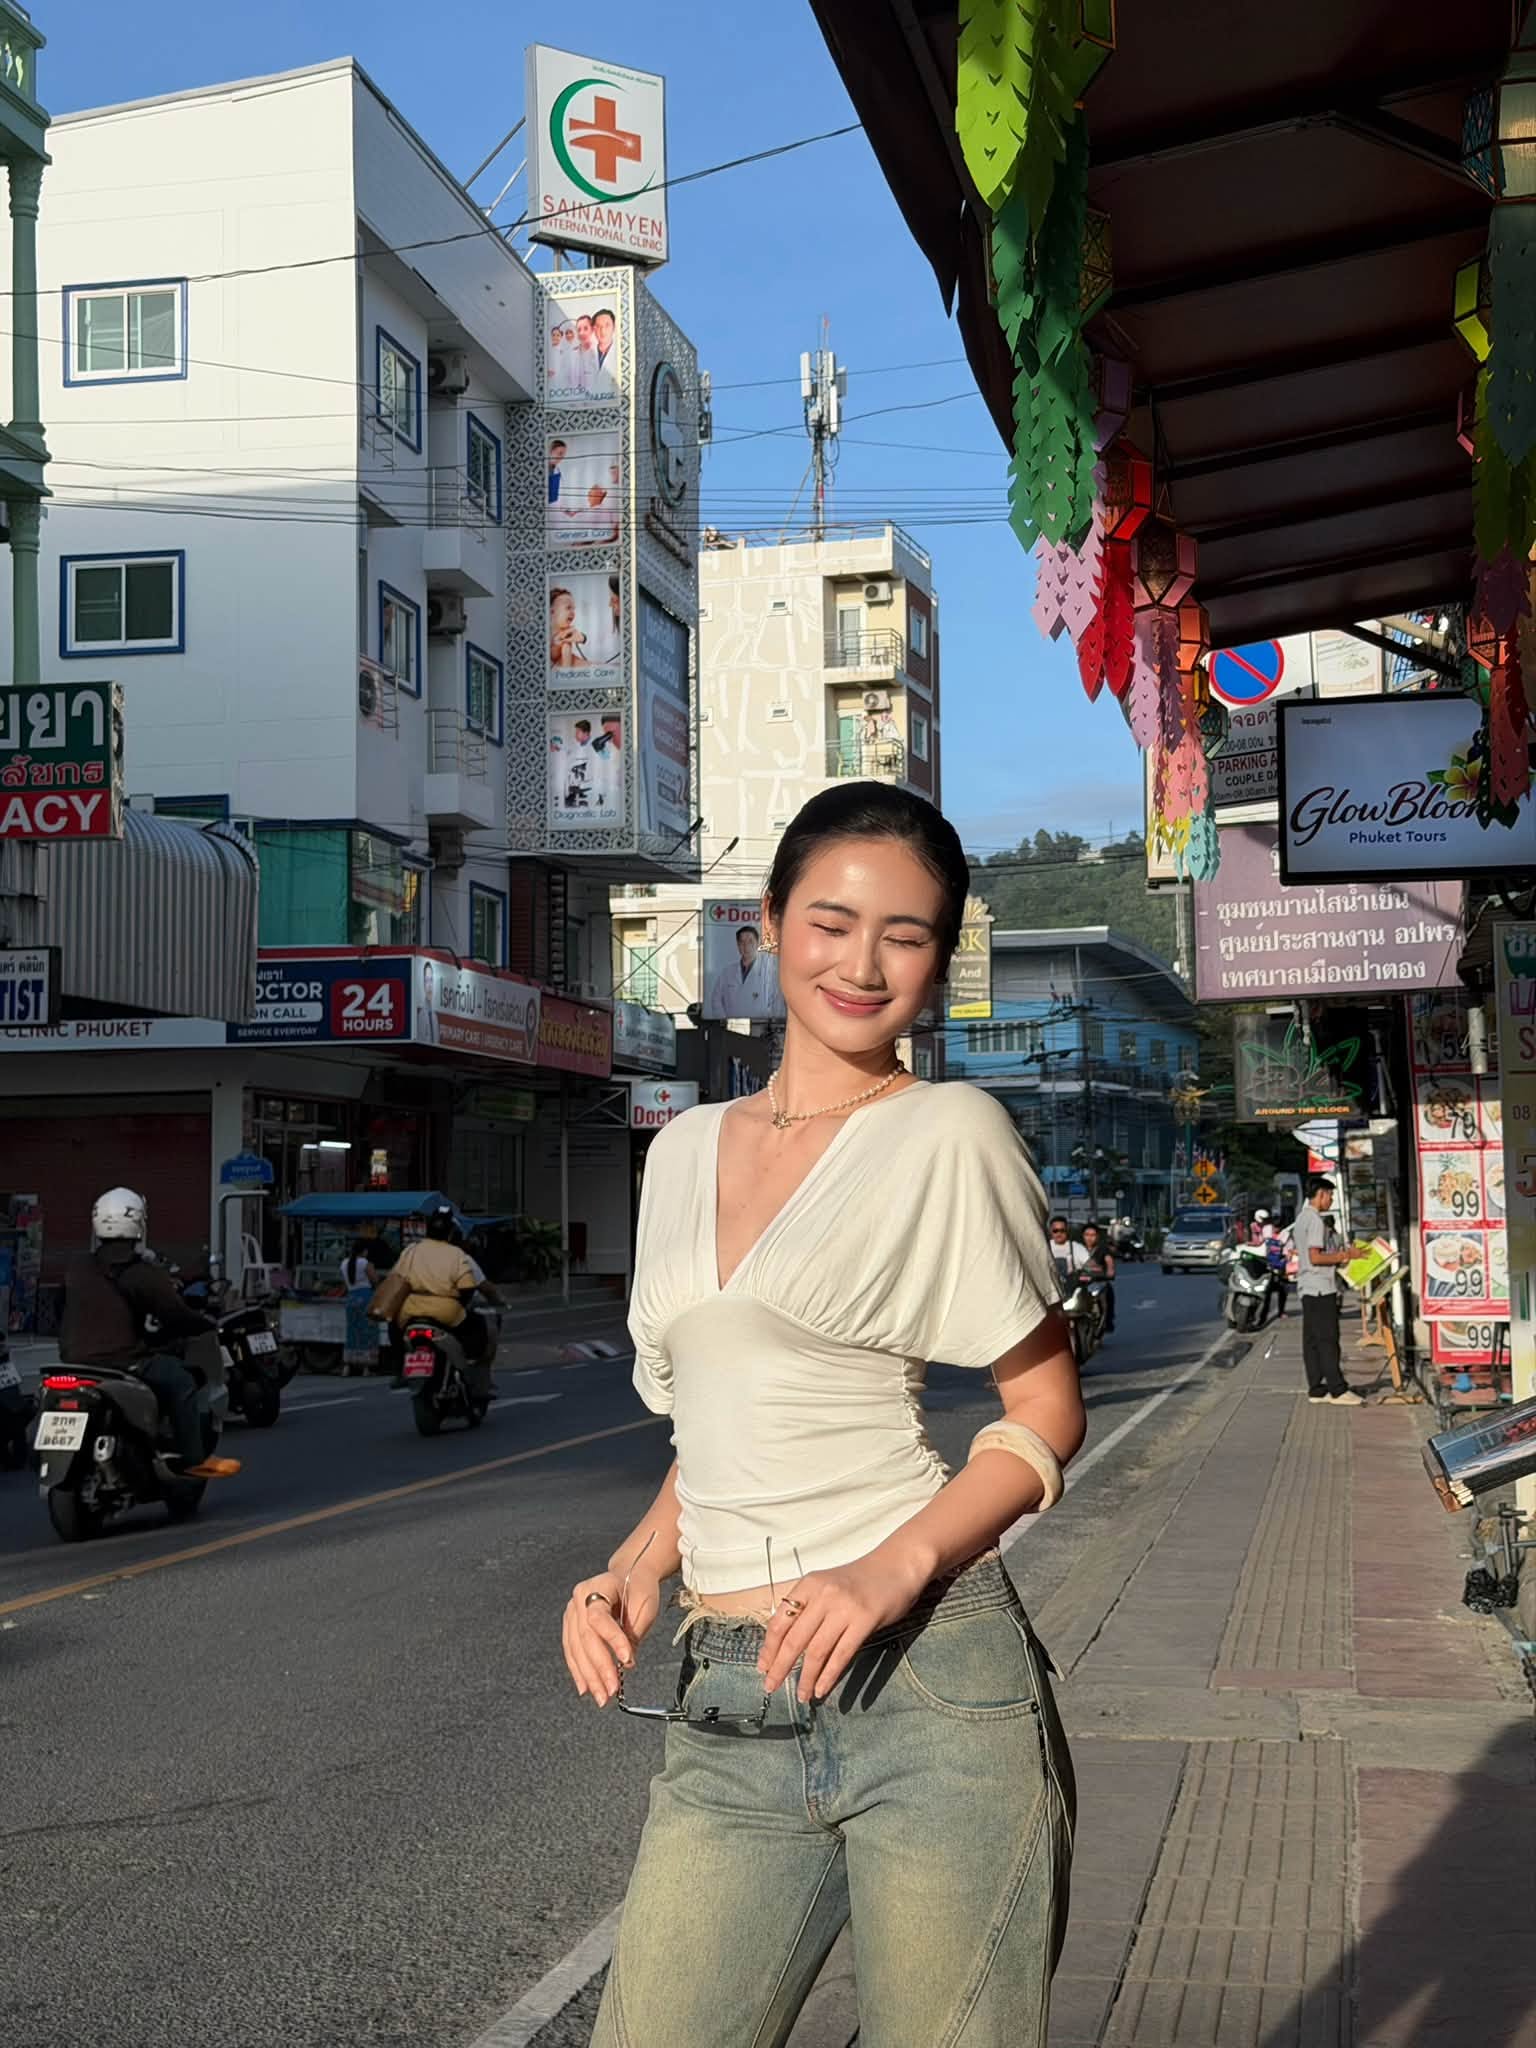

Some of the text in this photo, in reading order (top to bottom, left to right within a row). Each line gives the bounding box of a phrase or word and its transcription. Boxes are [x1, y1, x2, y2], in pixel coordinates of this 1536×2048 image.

[543, 194, 663, 238] SAINAMYEN
[542, 217, 663, 252] INTERNATIONAL CLINIC
[594, 668, 615, 677] Care
[1218, 754, 1268, 775] PARKING
[1225, 771, 1264, 786] COUPLE
[599, 807, 616, 818] Lab
[1349, 830, 1447, 844] Phuket Tours
[1219, 922, 1385, 960] ศูนย์ประสานงาน
[959, 967, 981, 978] And
[1221, 951, 1426, 988] เทศบาลเมืองป่าตอง
[342, 983, 394, 1018] 24
[272, 1007, 306, 1018] CALL
[75, 1021, 152, 1037] PHUKET
[237, 1026, 318, 1037] SERVICE EVERYDAY
[343, 1018, 394, 1032] HOURS
[633, 1105, 685, 1125] Doct
[1254, 1105, 1350, 1116] AROUND THE CLOCK
[1450, 1111, 1476, 1140] 79
[1451, 1190, 1479, 1217] 99
[1455, 1269, 1483, 1297] 99
[1467, 1324, 1492, 1350] 99
